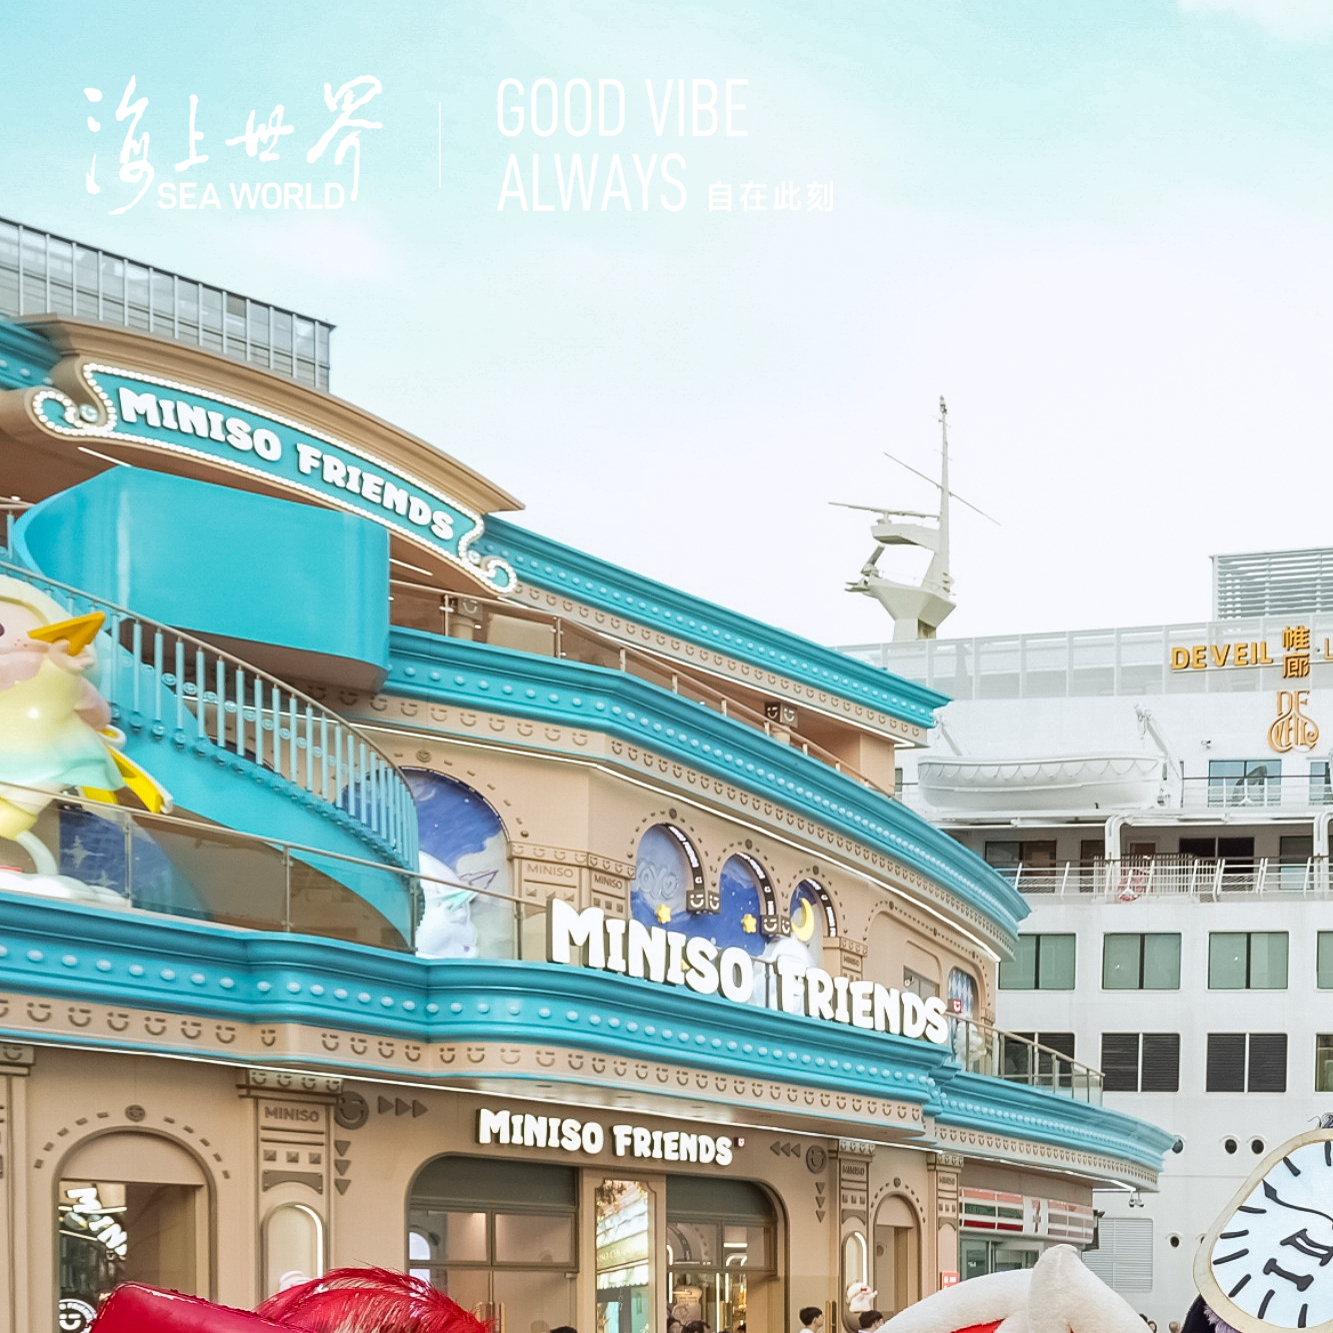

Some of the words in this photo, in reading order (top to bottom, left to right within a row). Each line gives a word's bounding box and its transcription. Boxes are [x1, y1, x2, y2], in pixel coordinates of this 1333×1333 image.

[118, 386, 283, 462] MINISO
[296, 442, 456, 542] FRIENDS
[1170, 641, 1274, 670] DEVEIL
[526, 863, 575, 879] MINISO
[594, 873, 623, 890] MINISO
[547, 897, 753, 1003] MINISO
[777, 955, 950, 1046] FRIENDS
[265, 1106, 321, 1123] MINISO
[477, 1107, 605, 1155] MINISO
[612, 1124, 734, 1166] FRIENDS
